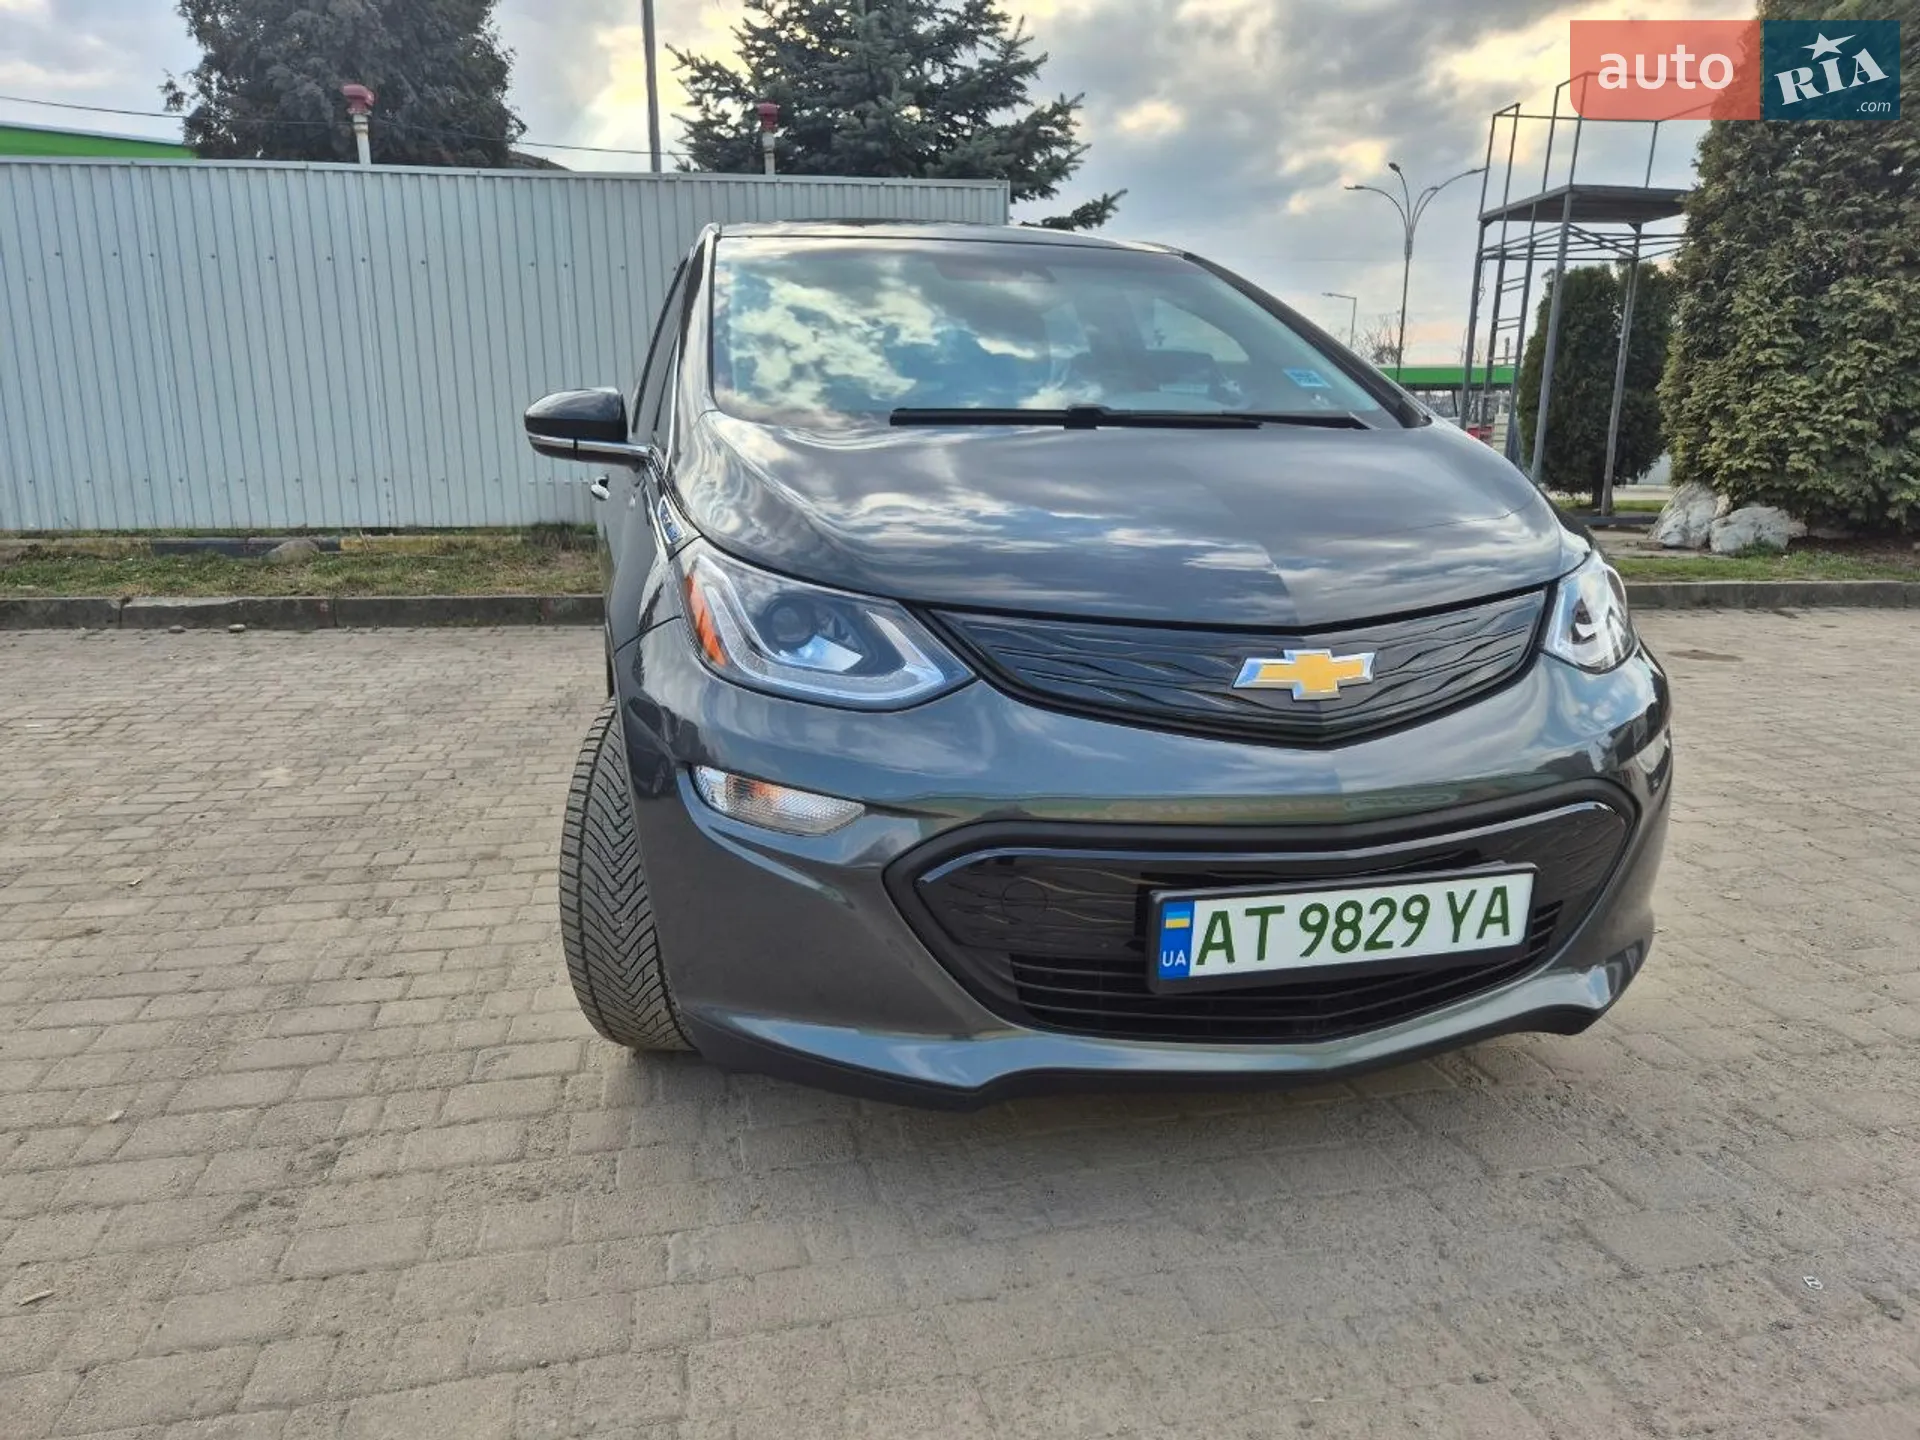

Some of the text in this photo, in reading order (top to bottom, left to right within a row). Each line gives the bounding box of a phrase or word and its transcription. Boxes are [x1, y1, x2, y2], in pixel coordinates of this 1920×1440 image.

[1196, 885, 1511, 965] AT 9829 YA
[1161, 950, 1187, 967] UA
